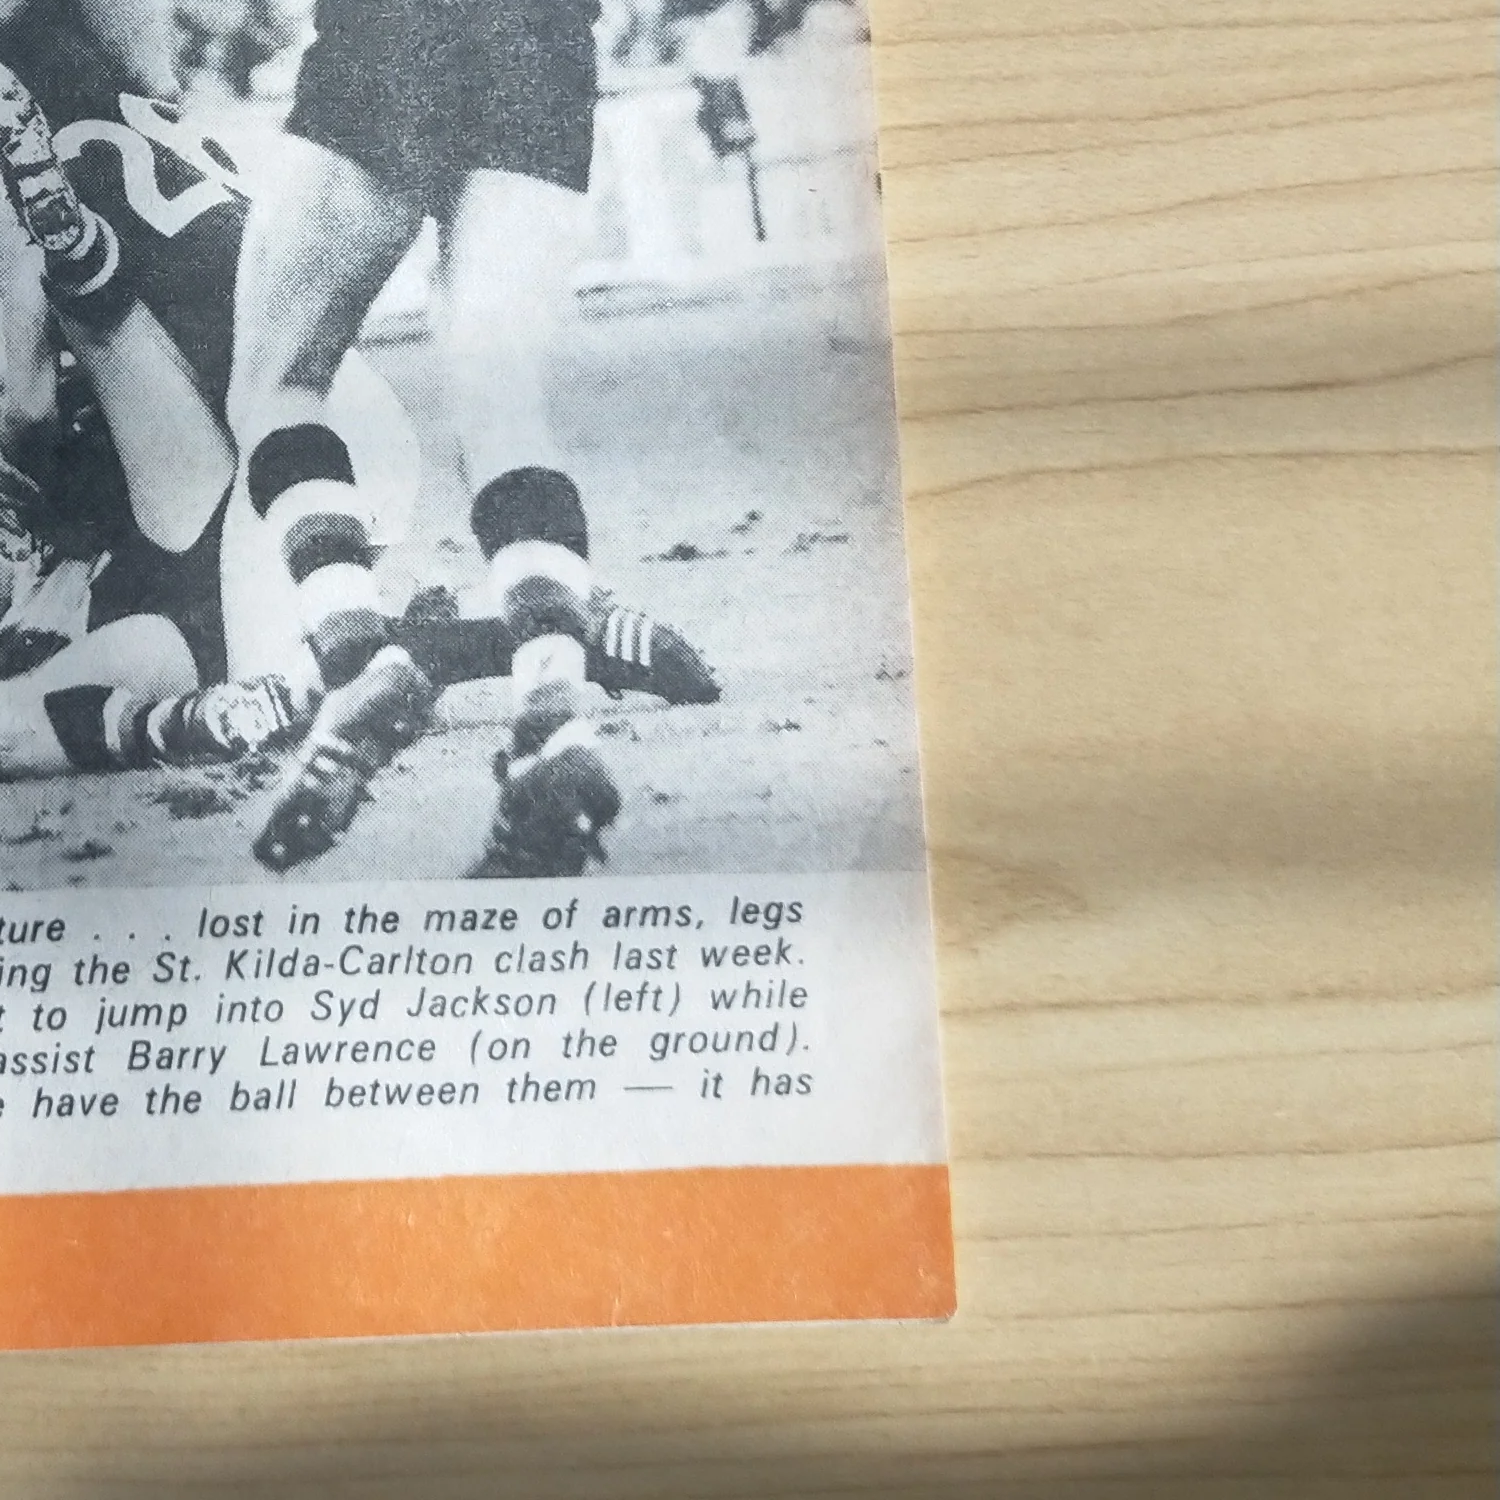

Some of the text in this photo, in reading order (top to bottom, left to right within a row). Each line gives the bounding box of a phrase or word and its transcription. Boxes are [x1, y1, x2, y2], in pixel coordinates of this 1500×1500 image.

[197, 906, 265, 939] lost
[287, 903, 321, 936] in
[343, 902, 401, 935] the
[423, 907, 520, 933] maze
[541, 897, 580, 931] of
[601, 904, 705, 931] arms,
[729, 895, 804, 931] legs
[73, 953, 131, 988] the
[152, 950, 202, 985] St.
[224, 943, 474, 982] Kilda-Carlton
[493, 939, 590, 975] clash
[612, 940, 678, 971] last
[700, 936, 805, 969] week.
[32, 1003, 68, 1033] to
[94, 996, 188, 1036] jump
[214, 992, 285, 1025] into
[309, 988, 381, 1028] Syd
[405, 985, 558, 1019] Jackson
[583, 980, 682, 1018] (left)
[710, 978, 809, 1012] while
[126, 1039, 228, 1077] Barry
[259, 1035, 437, 1068] Lawrence
[469, 1028, 532, 1067] (on
[561, 1027, 619, 1060] the
[648, 1021, 810, 1063] ground).
[31, 1086, 120, 1120] have
[145, 1082, 203, 1117] the
[228, 1078, 297, 1113] ball
[323, 1076, 480, 1110] between
[506, 1071, 597, 1105] them
[699, 1067, 724, 1101] it
[749, 1065, 814, 1097] has
